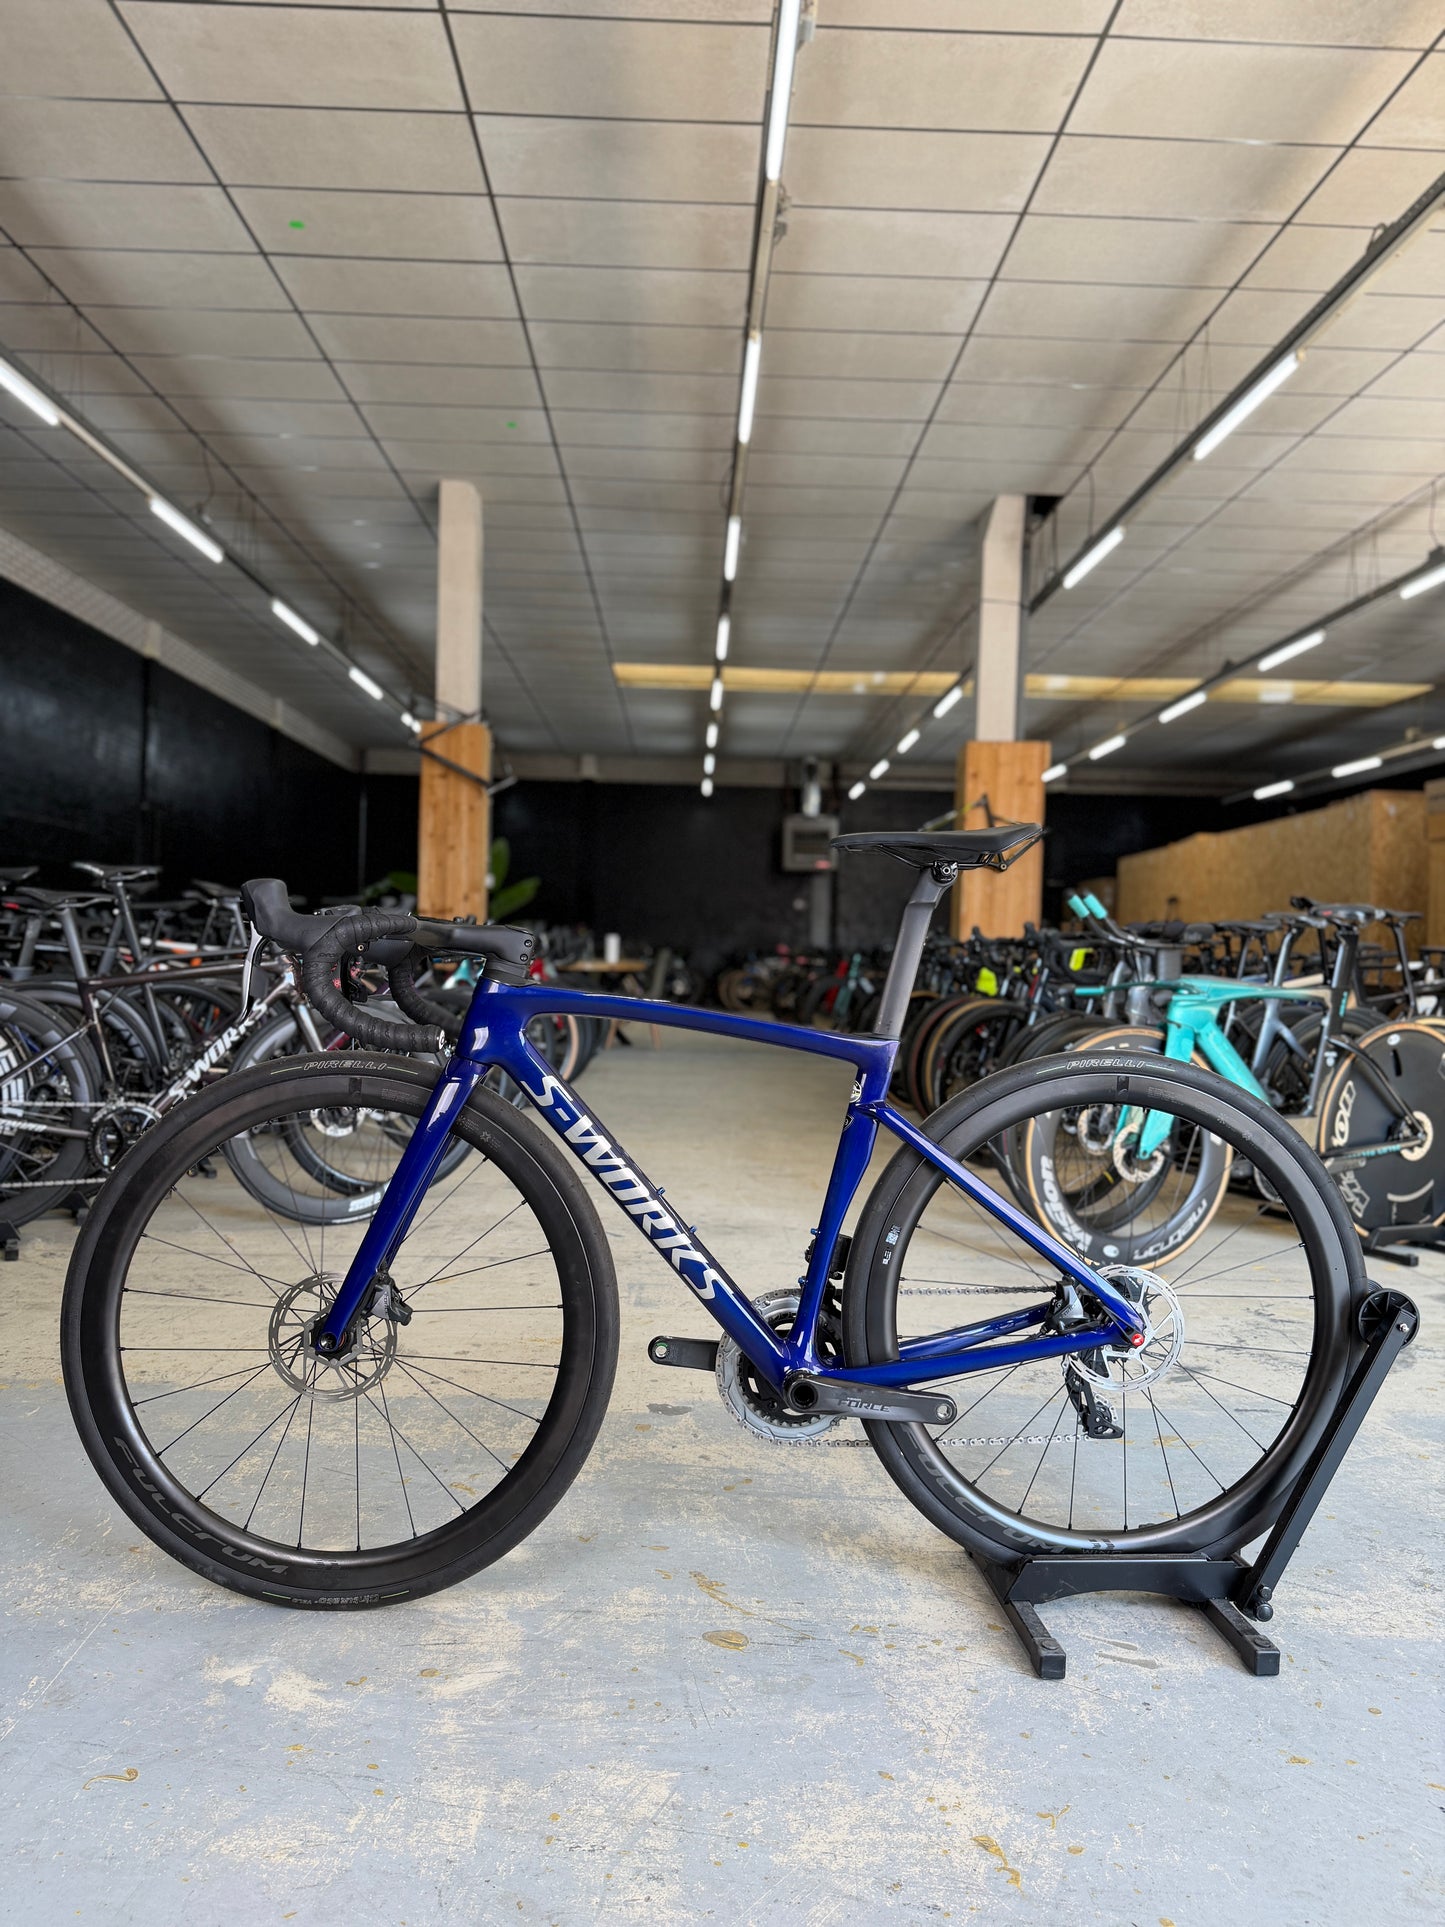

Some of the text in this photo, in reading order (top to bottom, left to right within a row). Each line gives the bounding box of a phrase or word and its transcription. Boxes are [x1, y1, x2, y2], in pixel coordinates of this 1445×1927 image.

[304, 1059, 388, 1071] PIRELLI
[1067, 1058, 1145, 1070] PIRELLI
[520, 1075, 734, 1300] S-WORKS
[838, 1400, 890, 1412] FORCE
[114, 1437, 288, 1574] FULCRUM
